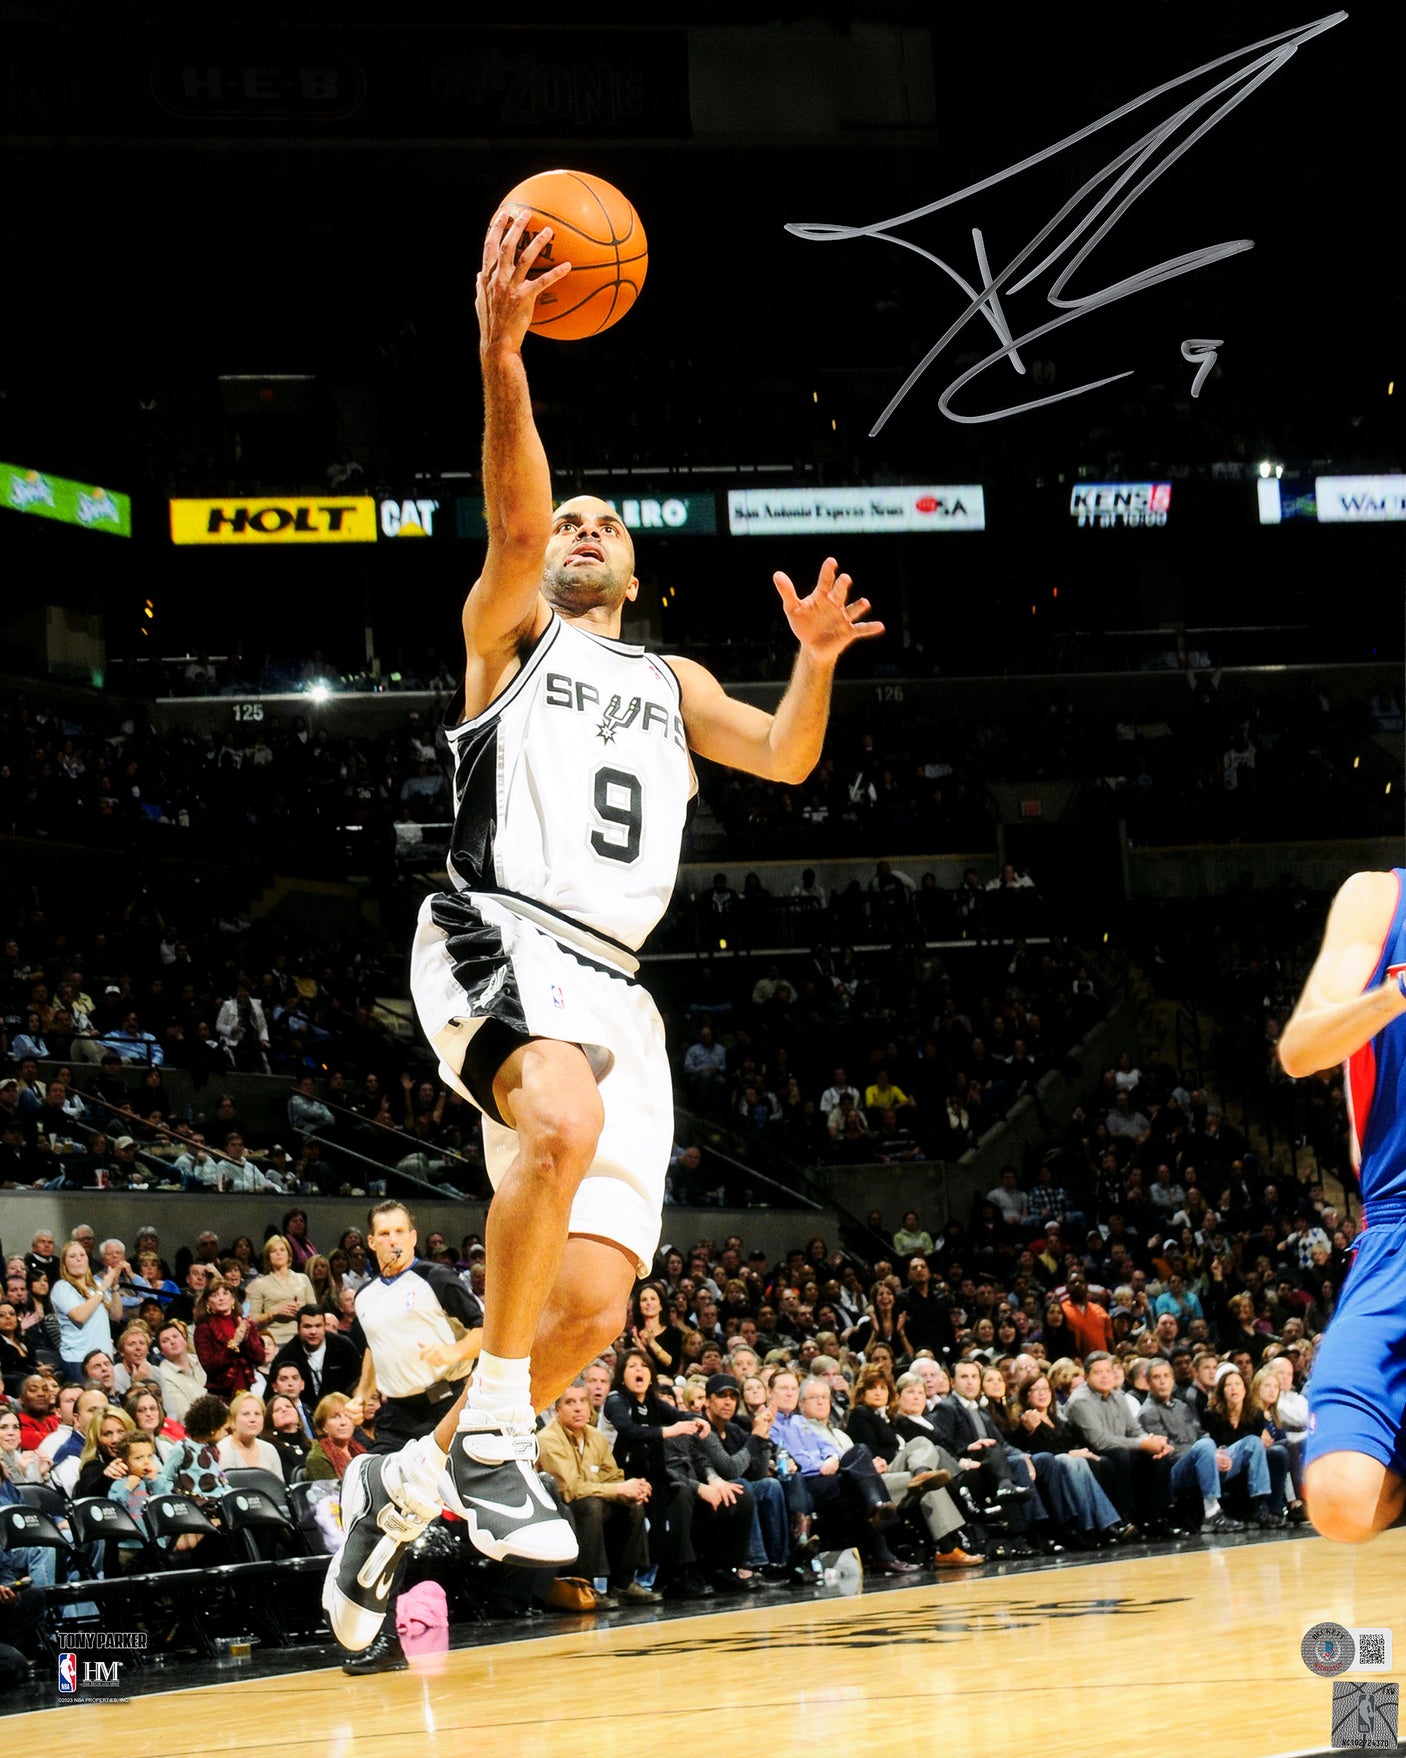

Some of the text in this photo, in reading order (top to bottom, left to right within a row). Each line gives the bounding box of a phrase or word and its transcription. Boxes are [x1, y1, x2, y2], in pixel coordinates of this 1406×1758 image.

[1181, 339, 1224, 398] 9
[208, 507, 357, 533] HOLT
[380, 499, 434, 538] CAT
[232, 704, 264, 721] 125
[589, 765, 643, 865] 9
[1312, 1628, 1345, 1641] BECKETT
